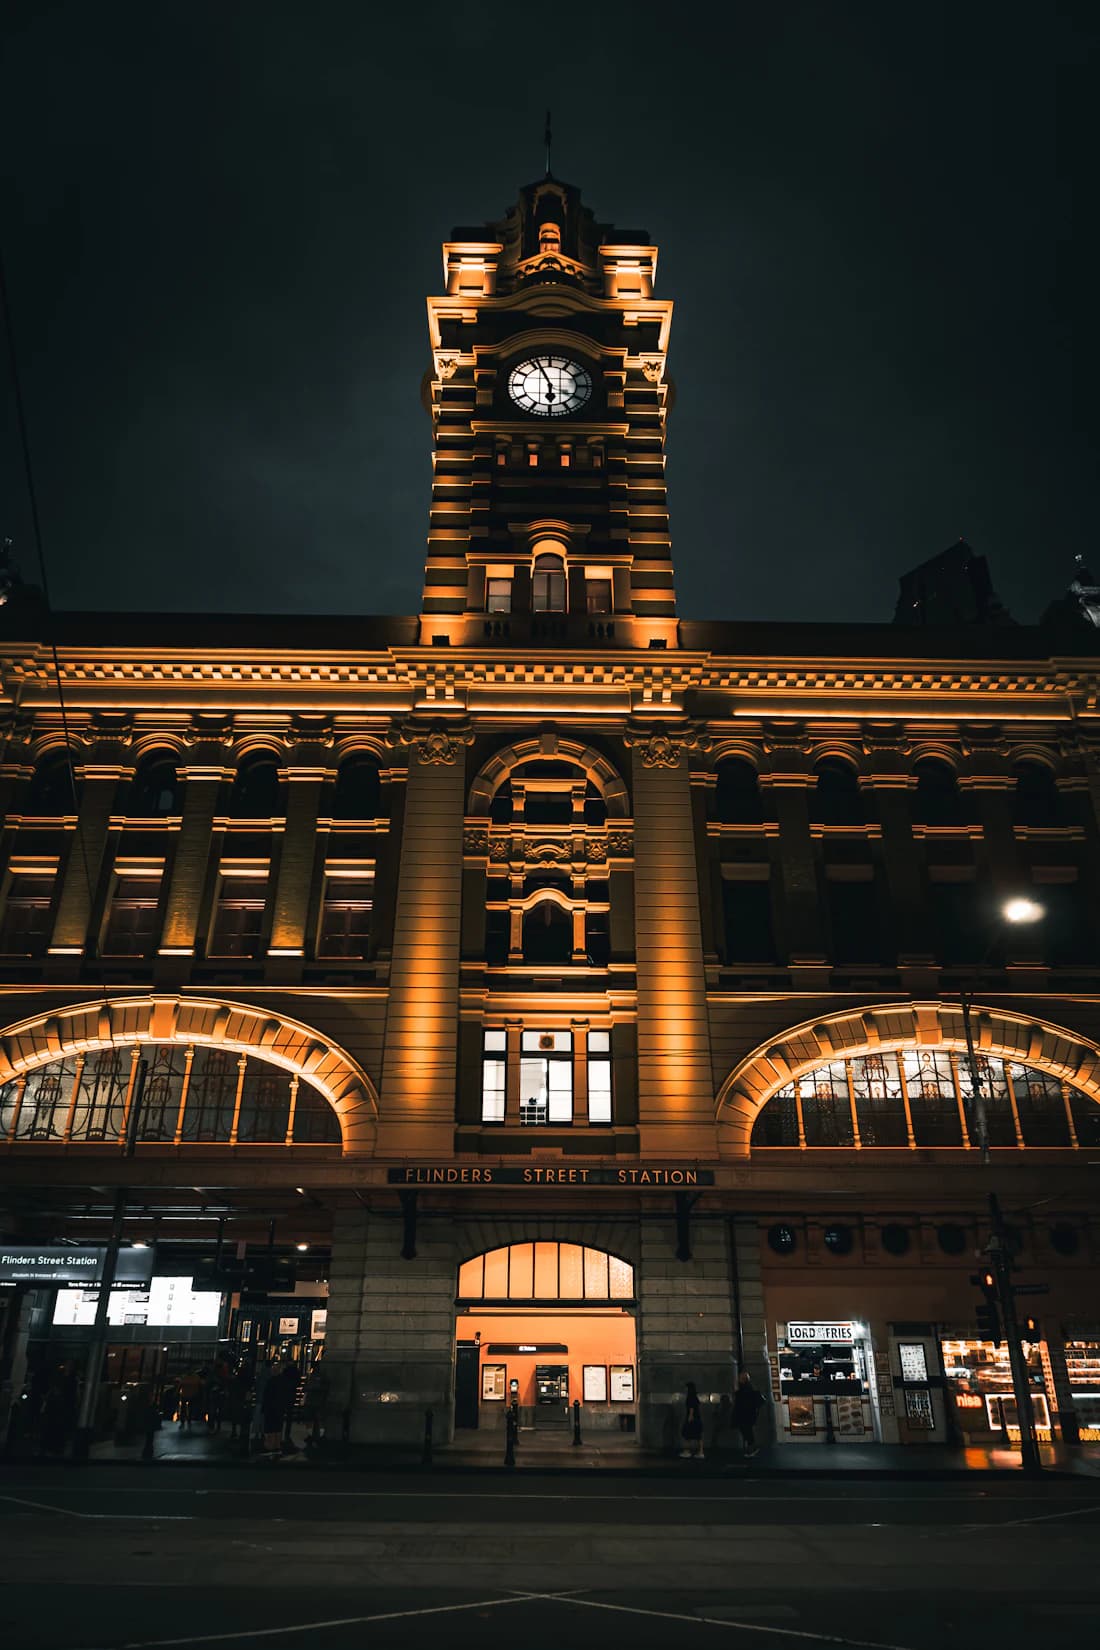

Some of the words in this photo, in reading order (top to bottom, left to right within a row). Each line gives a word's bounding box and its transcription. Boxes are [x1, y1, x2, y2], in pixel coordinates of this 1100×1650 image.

[405, 1168, 492, 1182] FLINDERS
[523, 1169, 590, 1183] STREET
[618, 1170, 697, 1184] STATION
[1, 1255, 35, 1265] Flinders
[38, 1256, 64, 1265] Street
[66, 1256, 98, 1265] Station
[789, 1327, 815, 1338] LORD
[825, 1327, 852, 1338] FRIES
